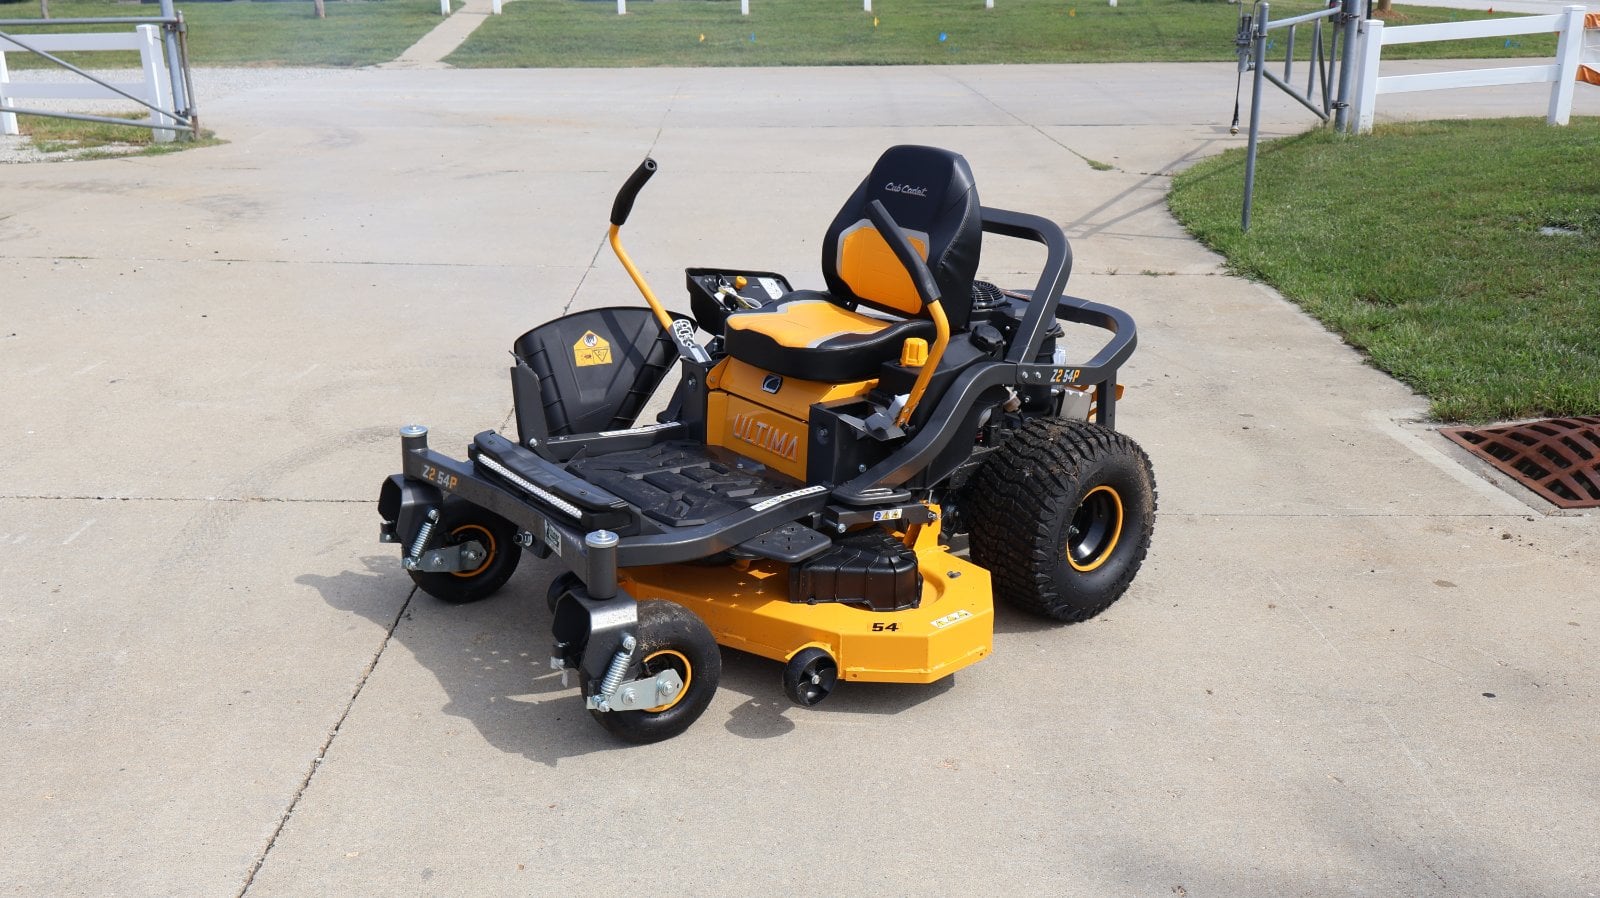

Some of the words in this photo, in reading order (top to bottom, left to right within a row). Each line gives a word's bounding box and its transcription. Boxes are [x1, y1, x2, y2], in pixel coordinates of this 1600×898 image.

[885, 182, 901, 192] Cub
[901, 184, 928, 197] Cadet
[1050, 368, 1063, 383] Z2
[1062, 369, 1080, 383] 54P
[733, 413, 798, 463] ULTIMA
[422, 464, 436, 480] Z2
[437, 470, 458, 489] 54P
[872, 622, 899, 632] 54
